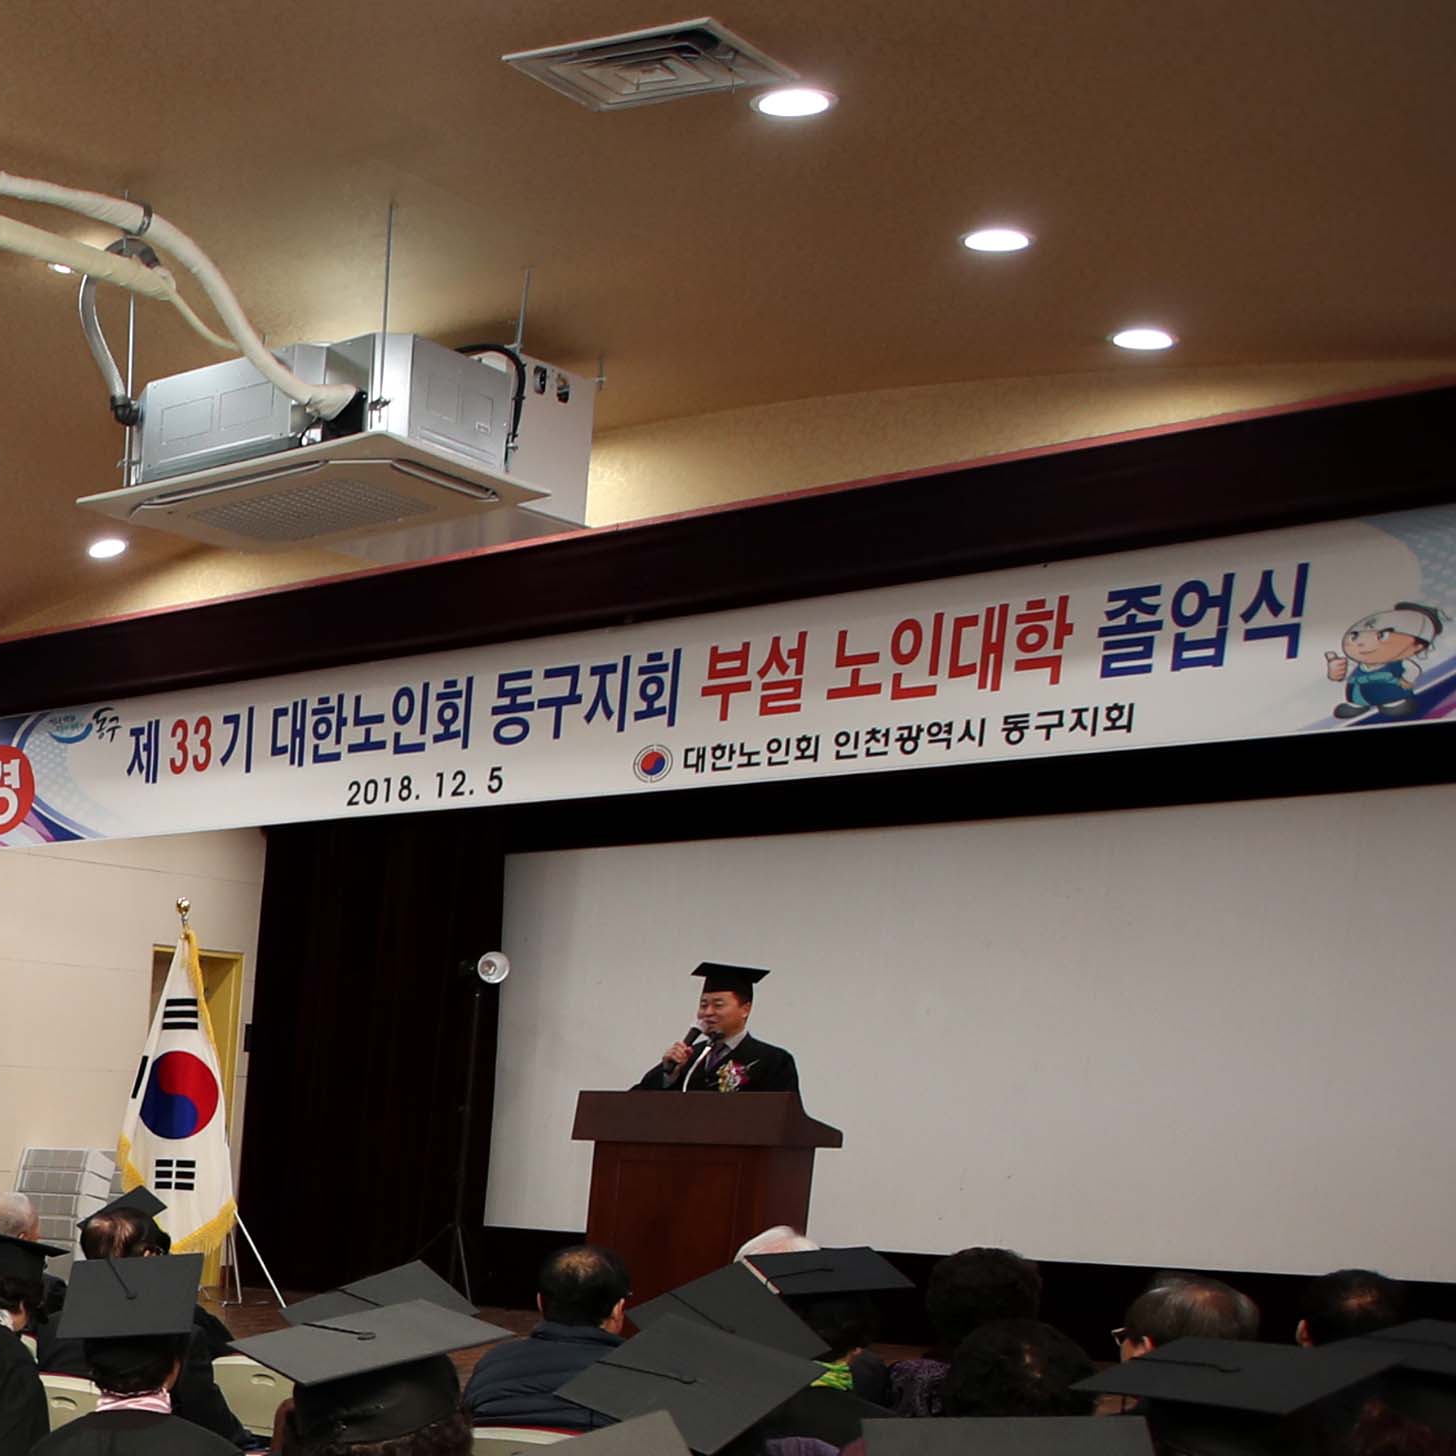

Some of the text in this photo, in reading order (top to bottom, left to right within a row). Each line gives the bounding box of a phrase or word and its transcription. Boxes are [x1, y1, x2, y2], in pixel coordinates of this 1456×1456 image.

[269, 675, 475, 769] 대한노인회
[490, 647, 683, 747] 동구지회
[700, 630, 809, 722] 부설
[825, 594, 1074, 701] 노인대학
[1096, 561, 1311, 680] 졸업식
[93, 706, 122, 742] 동구
[682, 702, 1135, 775] 대한노인회 인천광역시 동구지회
[345, 765, 504, 807] 2018. 12. 5
